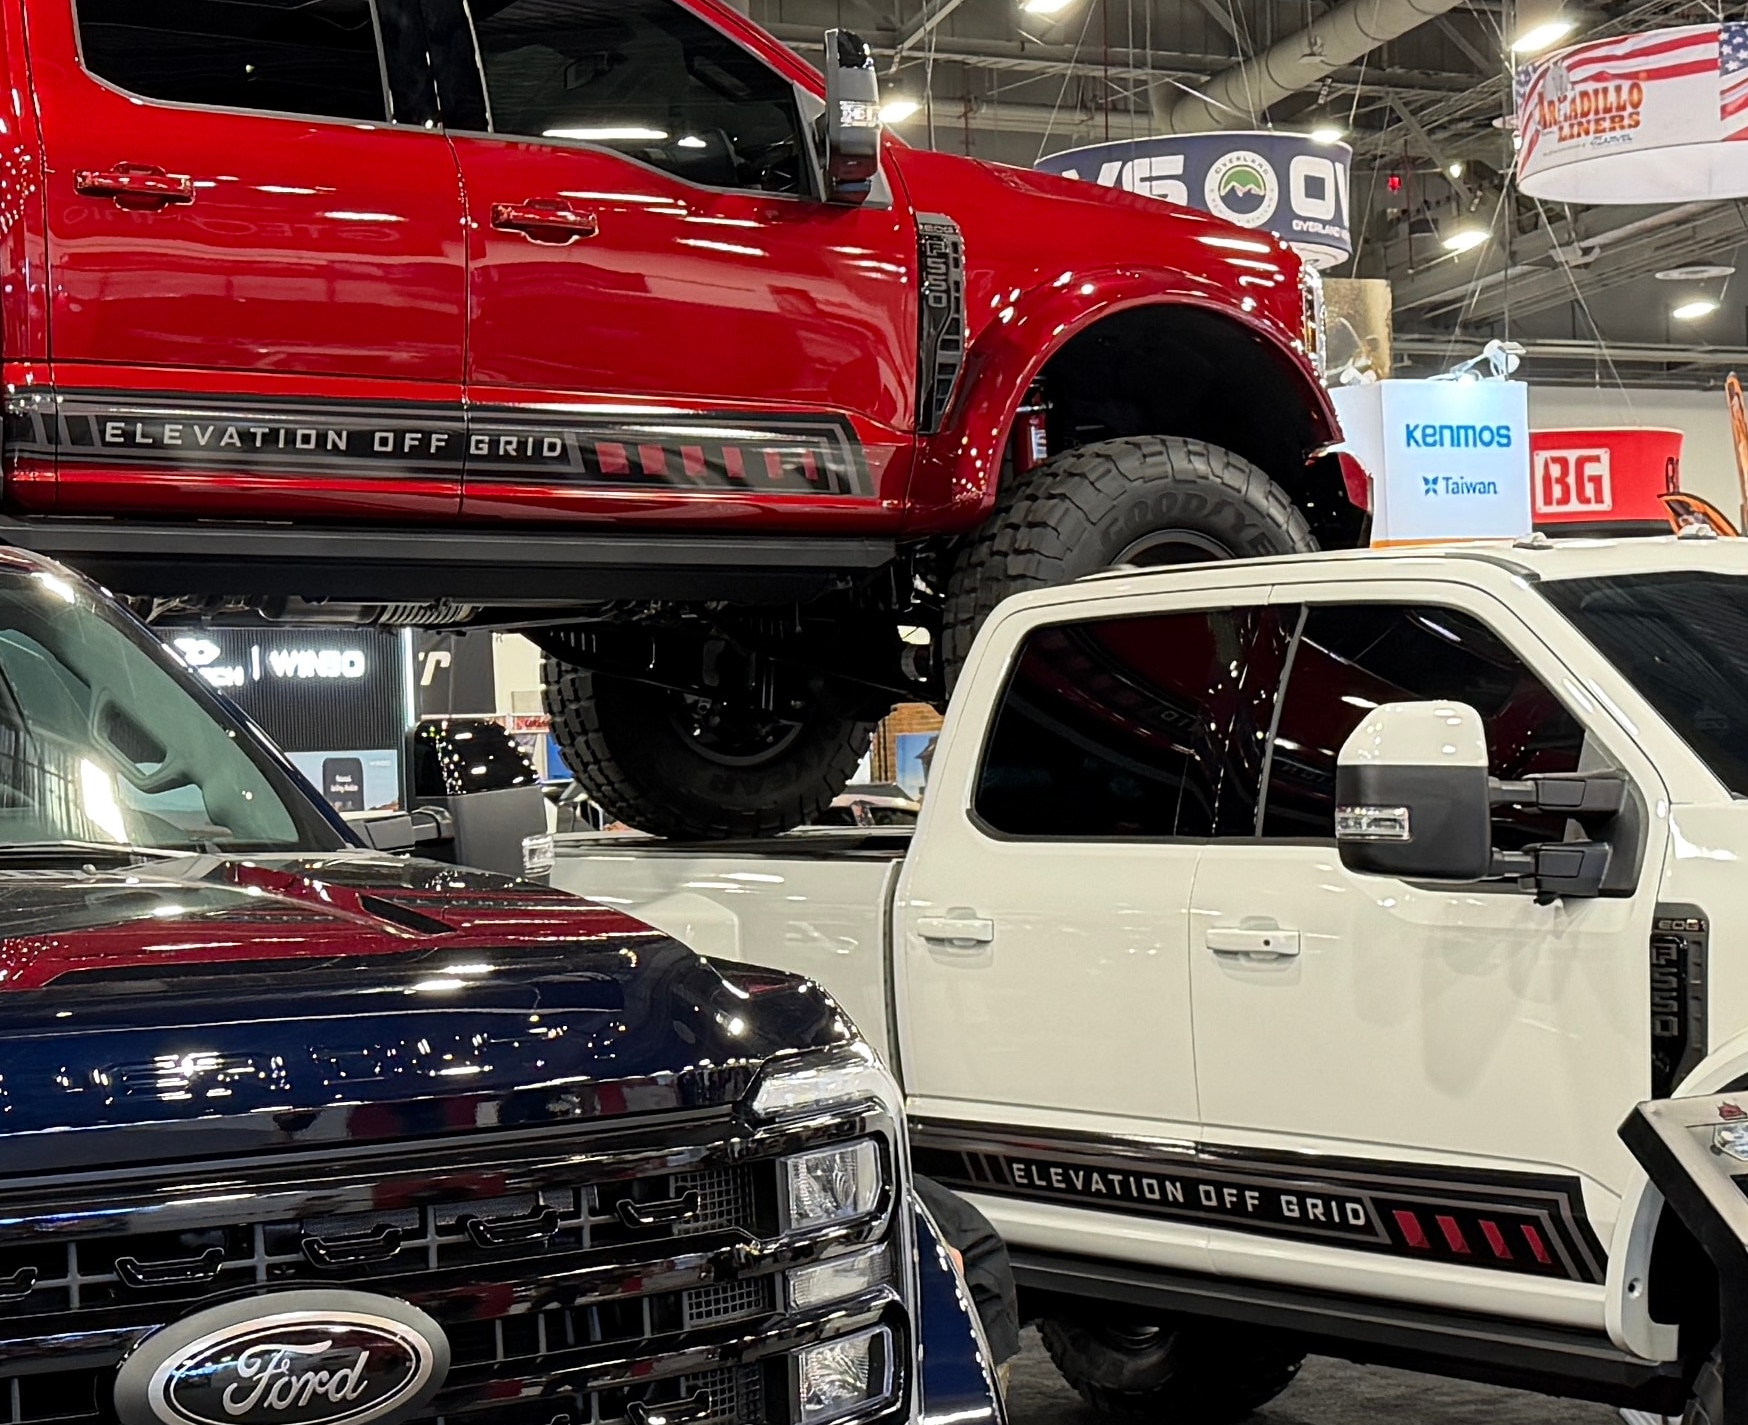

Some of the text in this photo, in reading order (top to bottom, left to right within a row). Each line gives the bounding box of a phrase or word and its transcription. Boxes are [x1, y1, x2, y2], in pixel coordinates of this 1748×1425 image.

[1557, 111, 1640, 142] LINERS
[104, 420, 566, 459] ELEVATION OFF GRID
[1442, 475, 1498, 495] Taiwan
[1542, 454, 1605, 506] BG
[1012, 1162, 1368, 1228] ELEVATION OFF GRID
[223, 1339, 369, 1417] Ford
